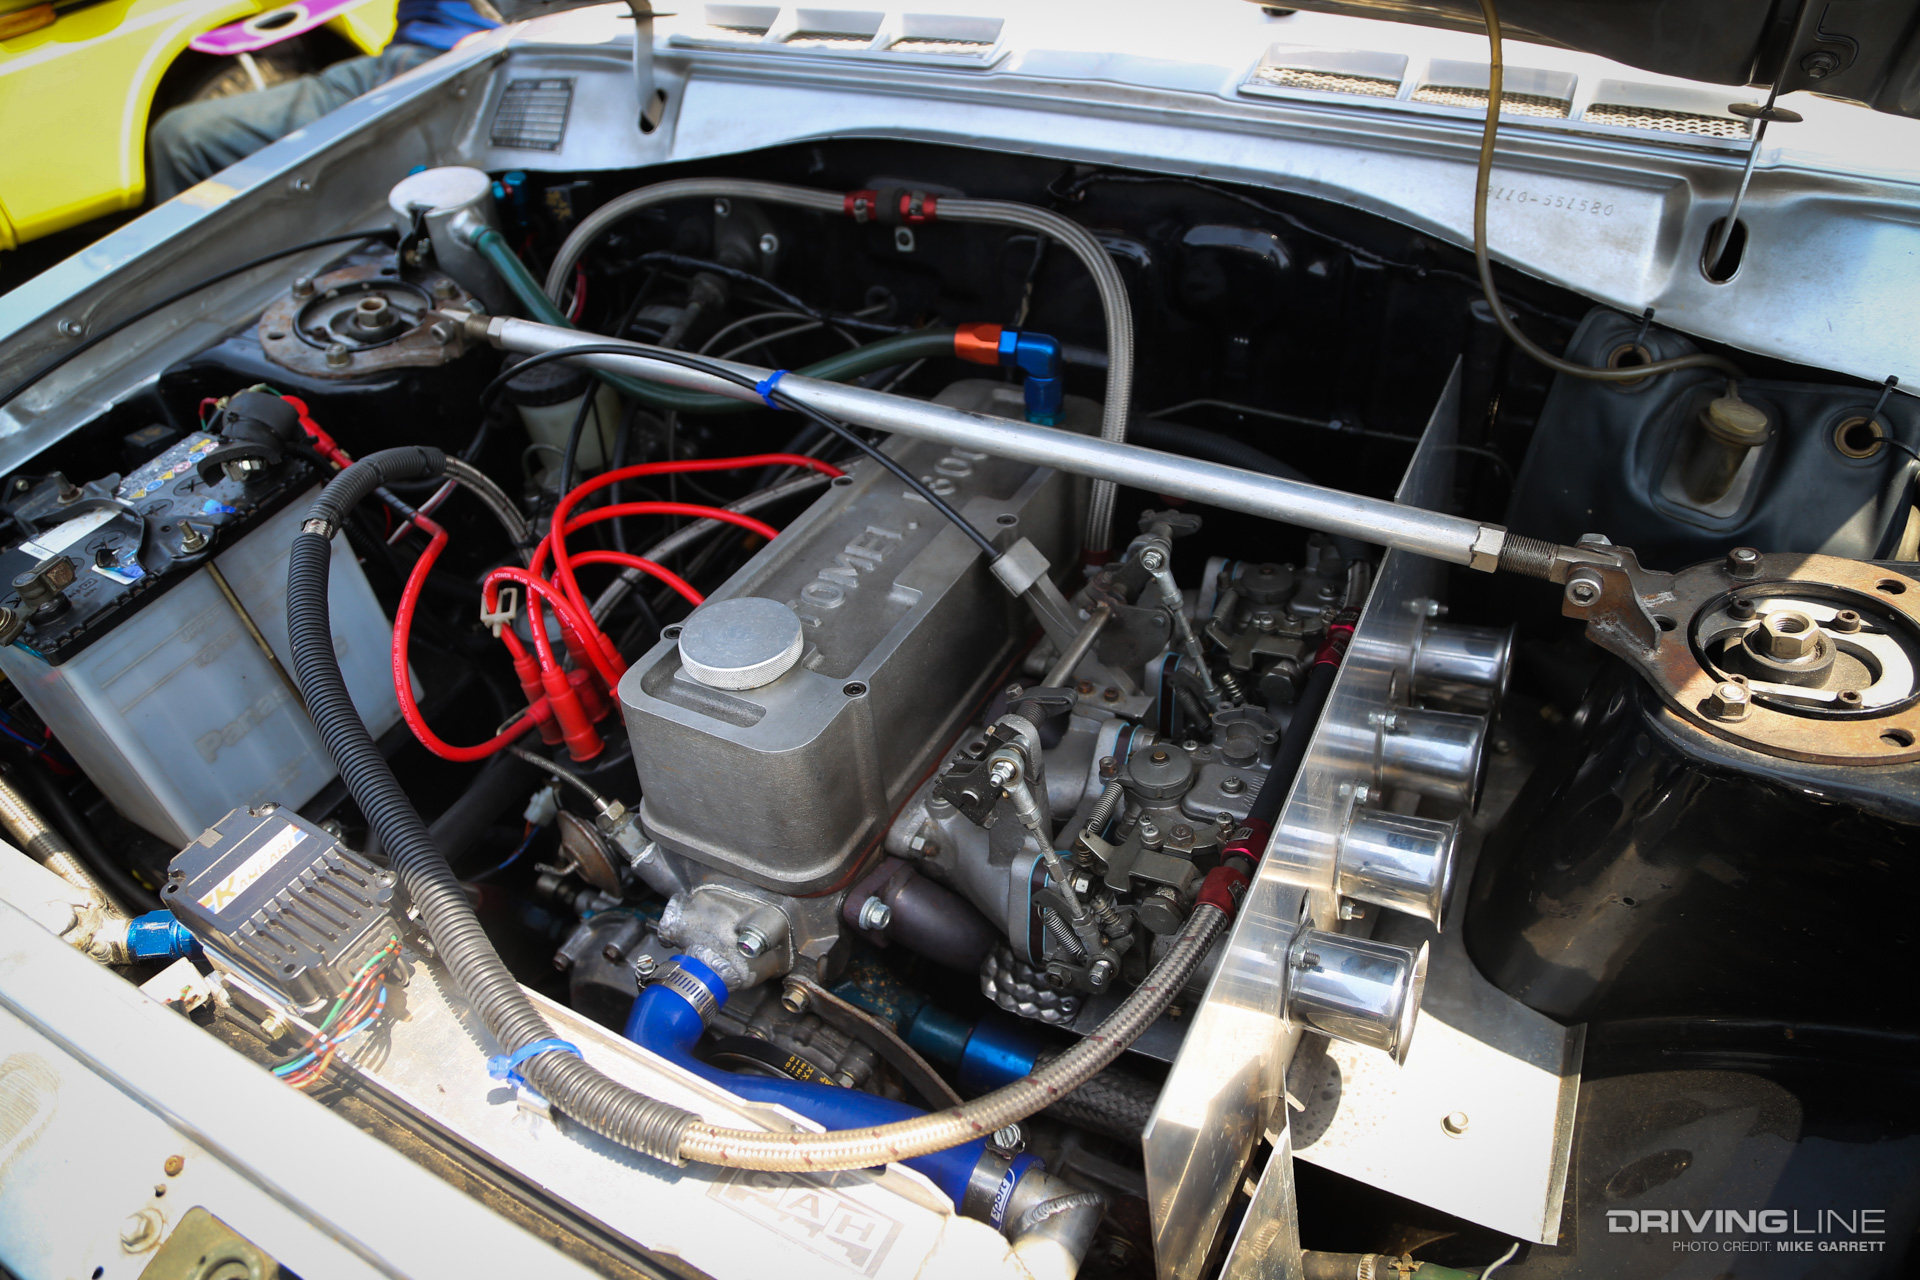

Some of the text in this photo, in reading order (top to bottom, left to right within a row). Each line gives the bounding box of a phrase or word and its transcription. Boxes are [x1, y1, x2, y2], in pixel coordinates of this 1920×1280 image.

[393, 629, 401, 649] WIRE
[393, 653, 401, 686] IGNITION
[992, 1181, 1007, 1218] sport
